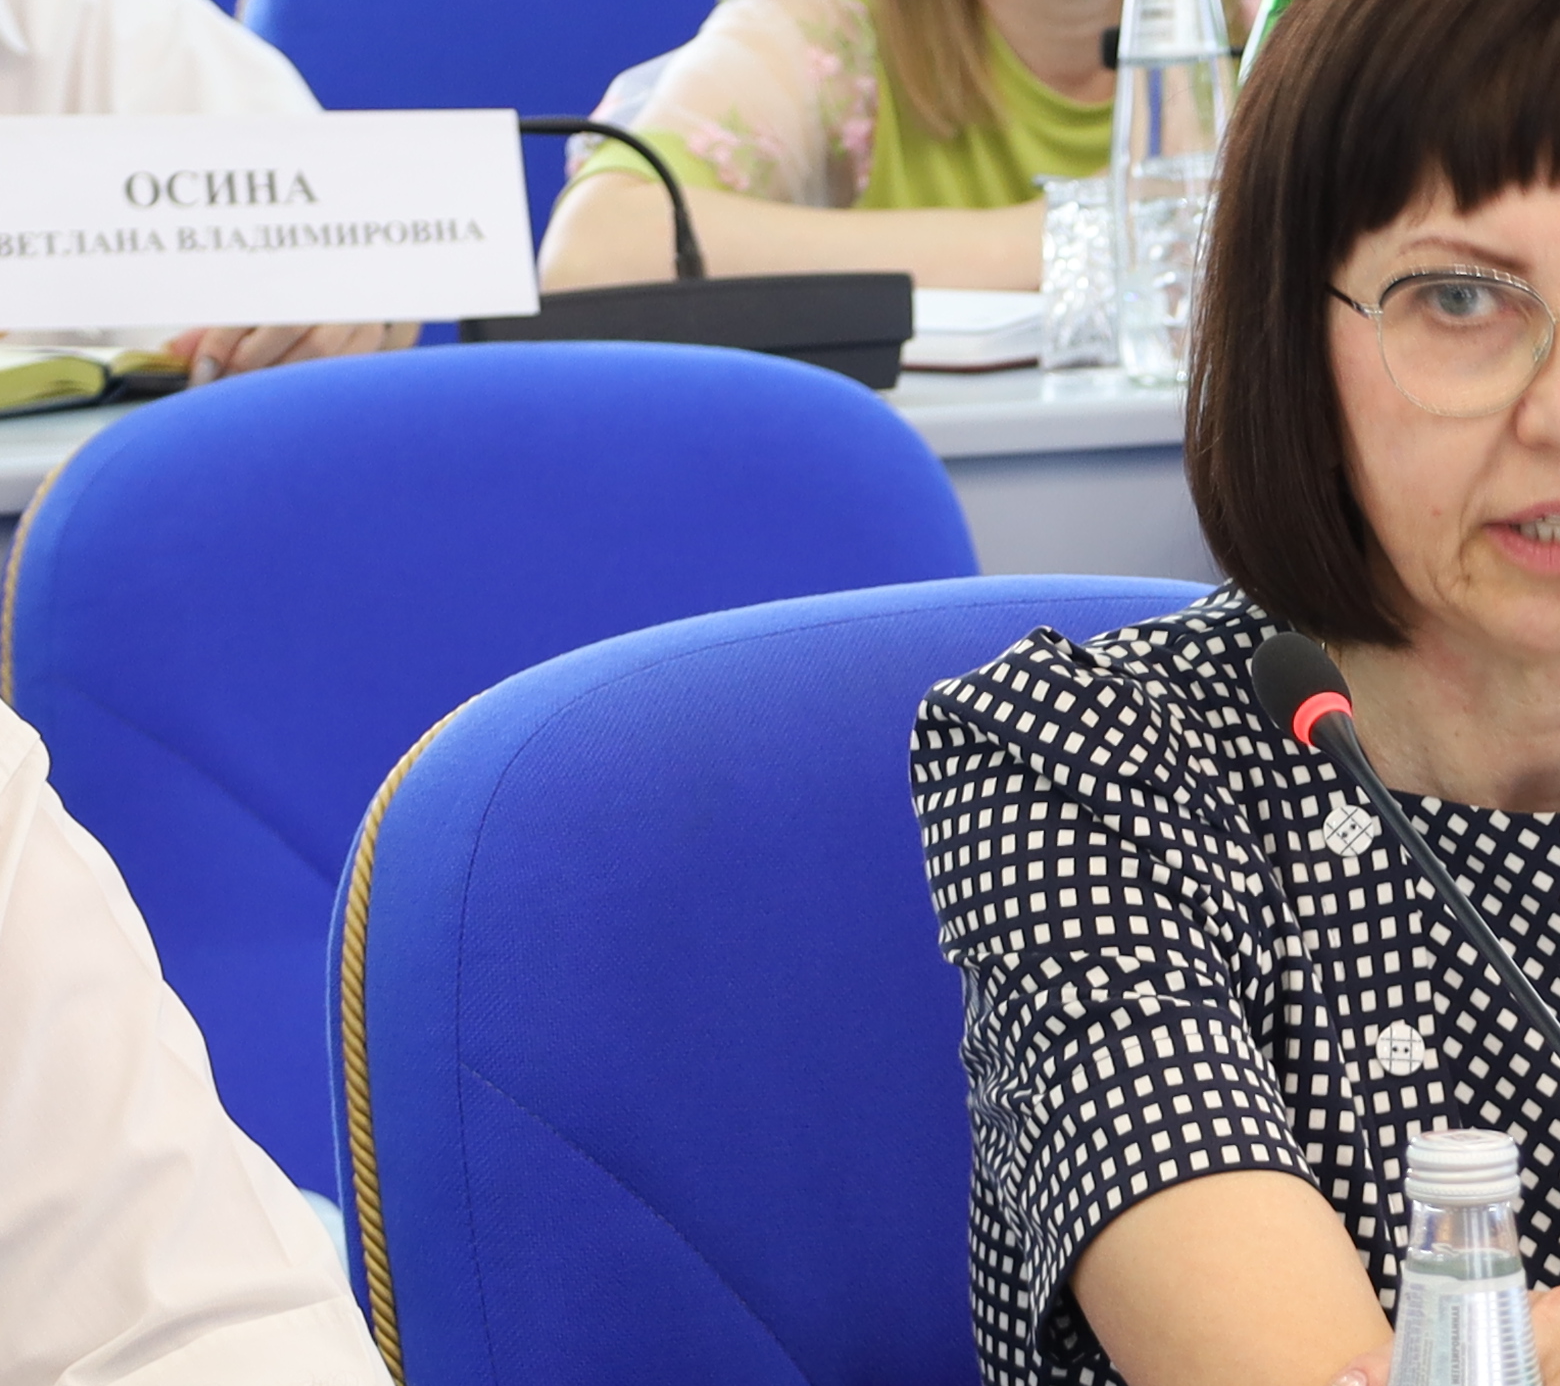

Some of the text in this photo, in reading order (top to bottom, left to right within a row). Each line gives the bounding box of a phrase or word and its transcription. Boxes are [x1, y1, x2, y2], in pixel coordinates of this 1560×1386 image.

[123, 169, 318, 208] ОСИНА
[176, 217, 485, 254] ВЛАДИМИРОВНА
[1450, 1304, 1460, 1386] НЕГАЗИРОВАННАЯ
